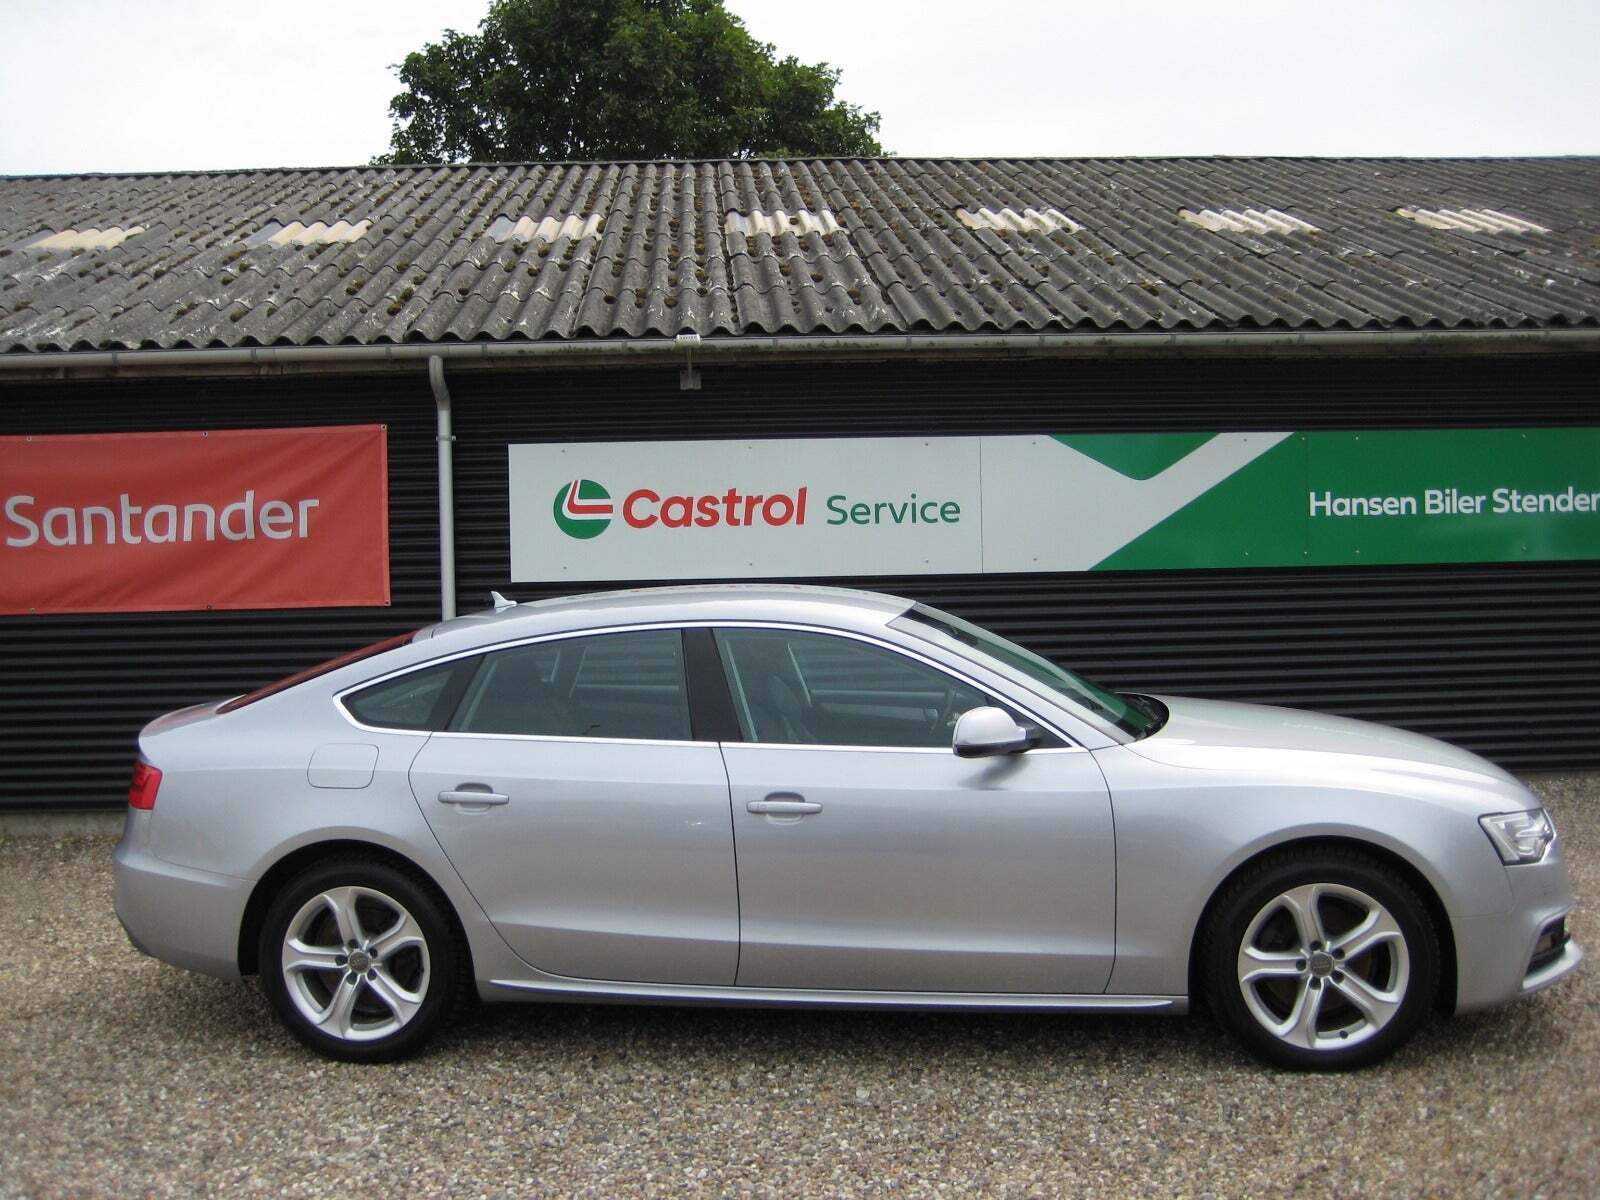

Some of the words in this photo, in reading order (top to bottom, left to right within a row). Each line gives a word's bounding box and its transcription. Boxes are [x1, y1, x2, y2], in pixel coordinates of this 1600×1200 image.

[5, 490, 319, 547] Santander
[623, 486, 808, 529] Castrol
[826, 493, 961, 525] Service
[1309, 491, 1417, 516] Hansen
[1424, 488, 1486, 514] Biler
